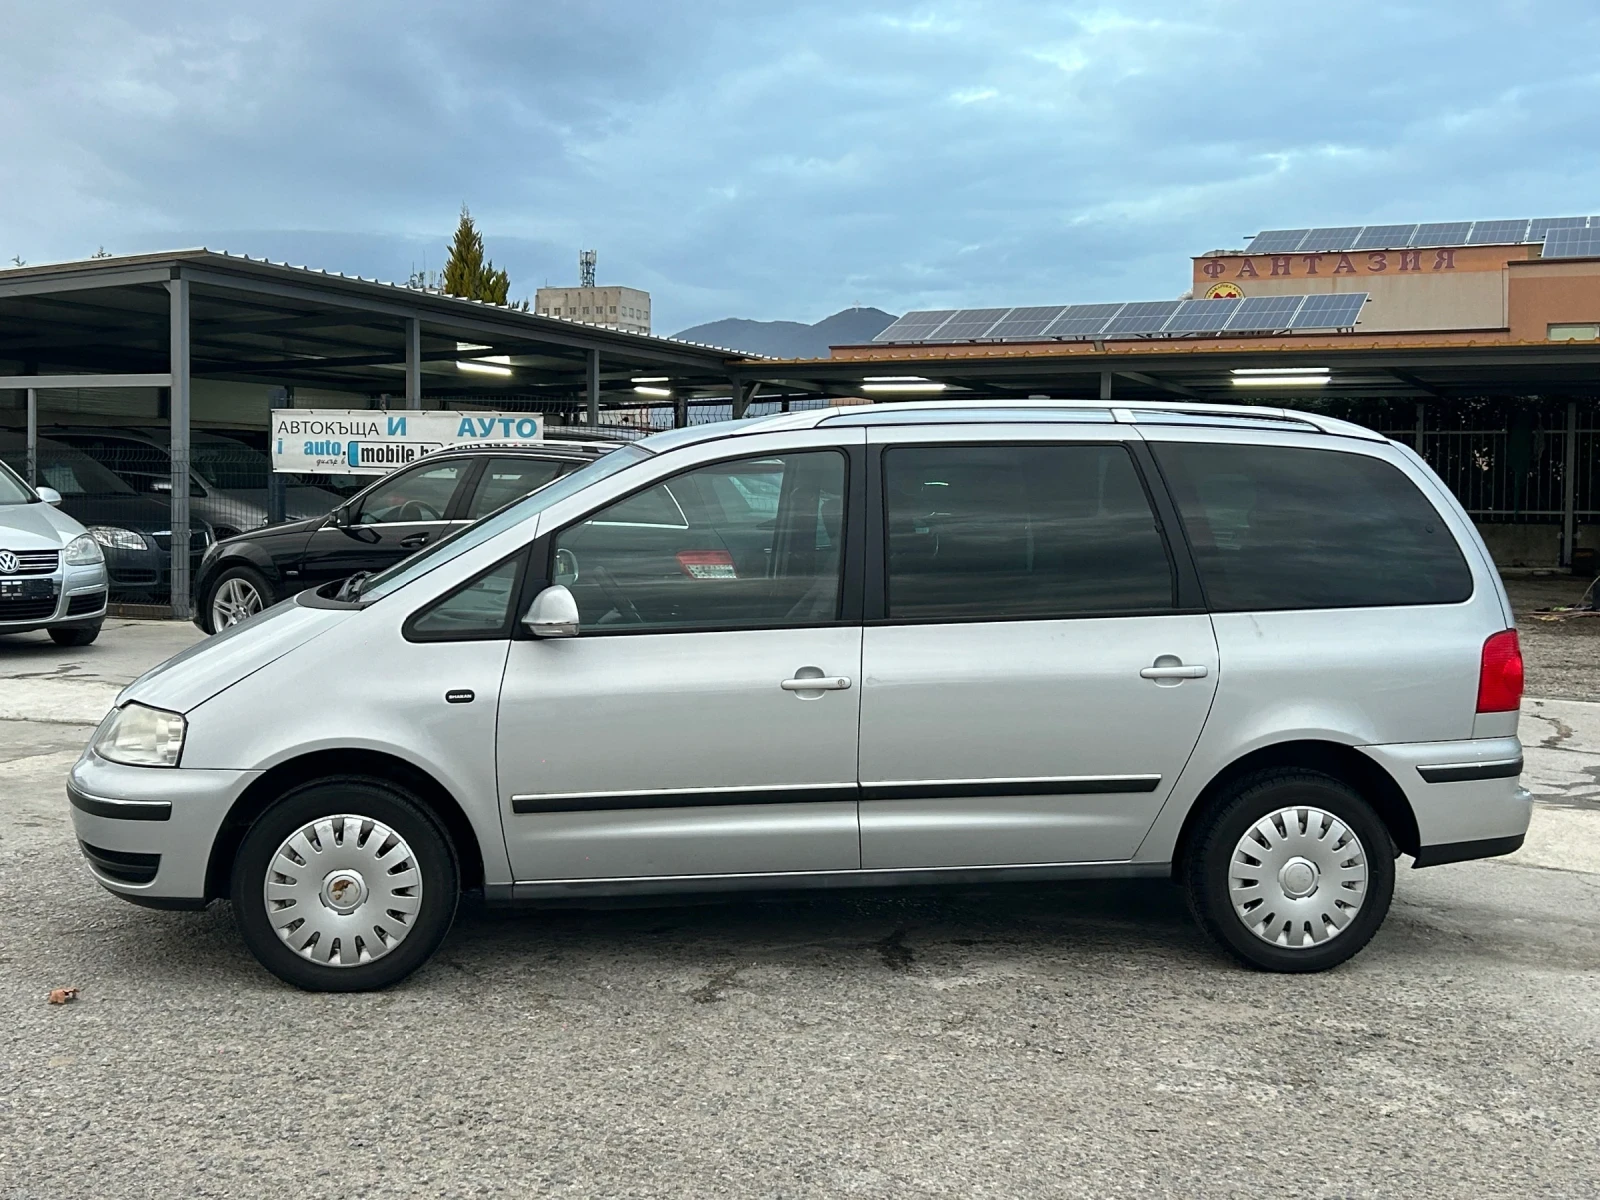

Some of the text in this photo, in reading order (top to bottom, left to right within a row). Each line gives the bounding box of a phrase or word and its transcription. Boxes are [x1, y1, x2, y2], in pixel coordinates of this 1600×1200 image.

[1203, 249, 1456, 278] ФАНТАЗИЯ
[277, 416, 538, 438] АВТОКЪЩА И АУТО
